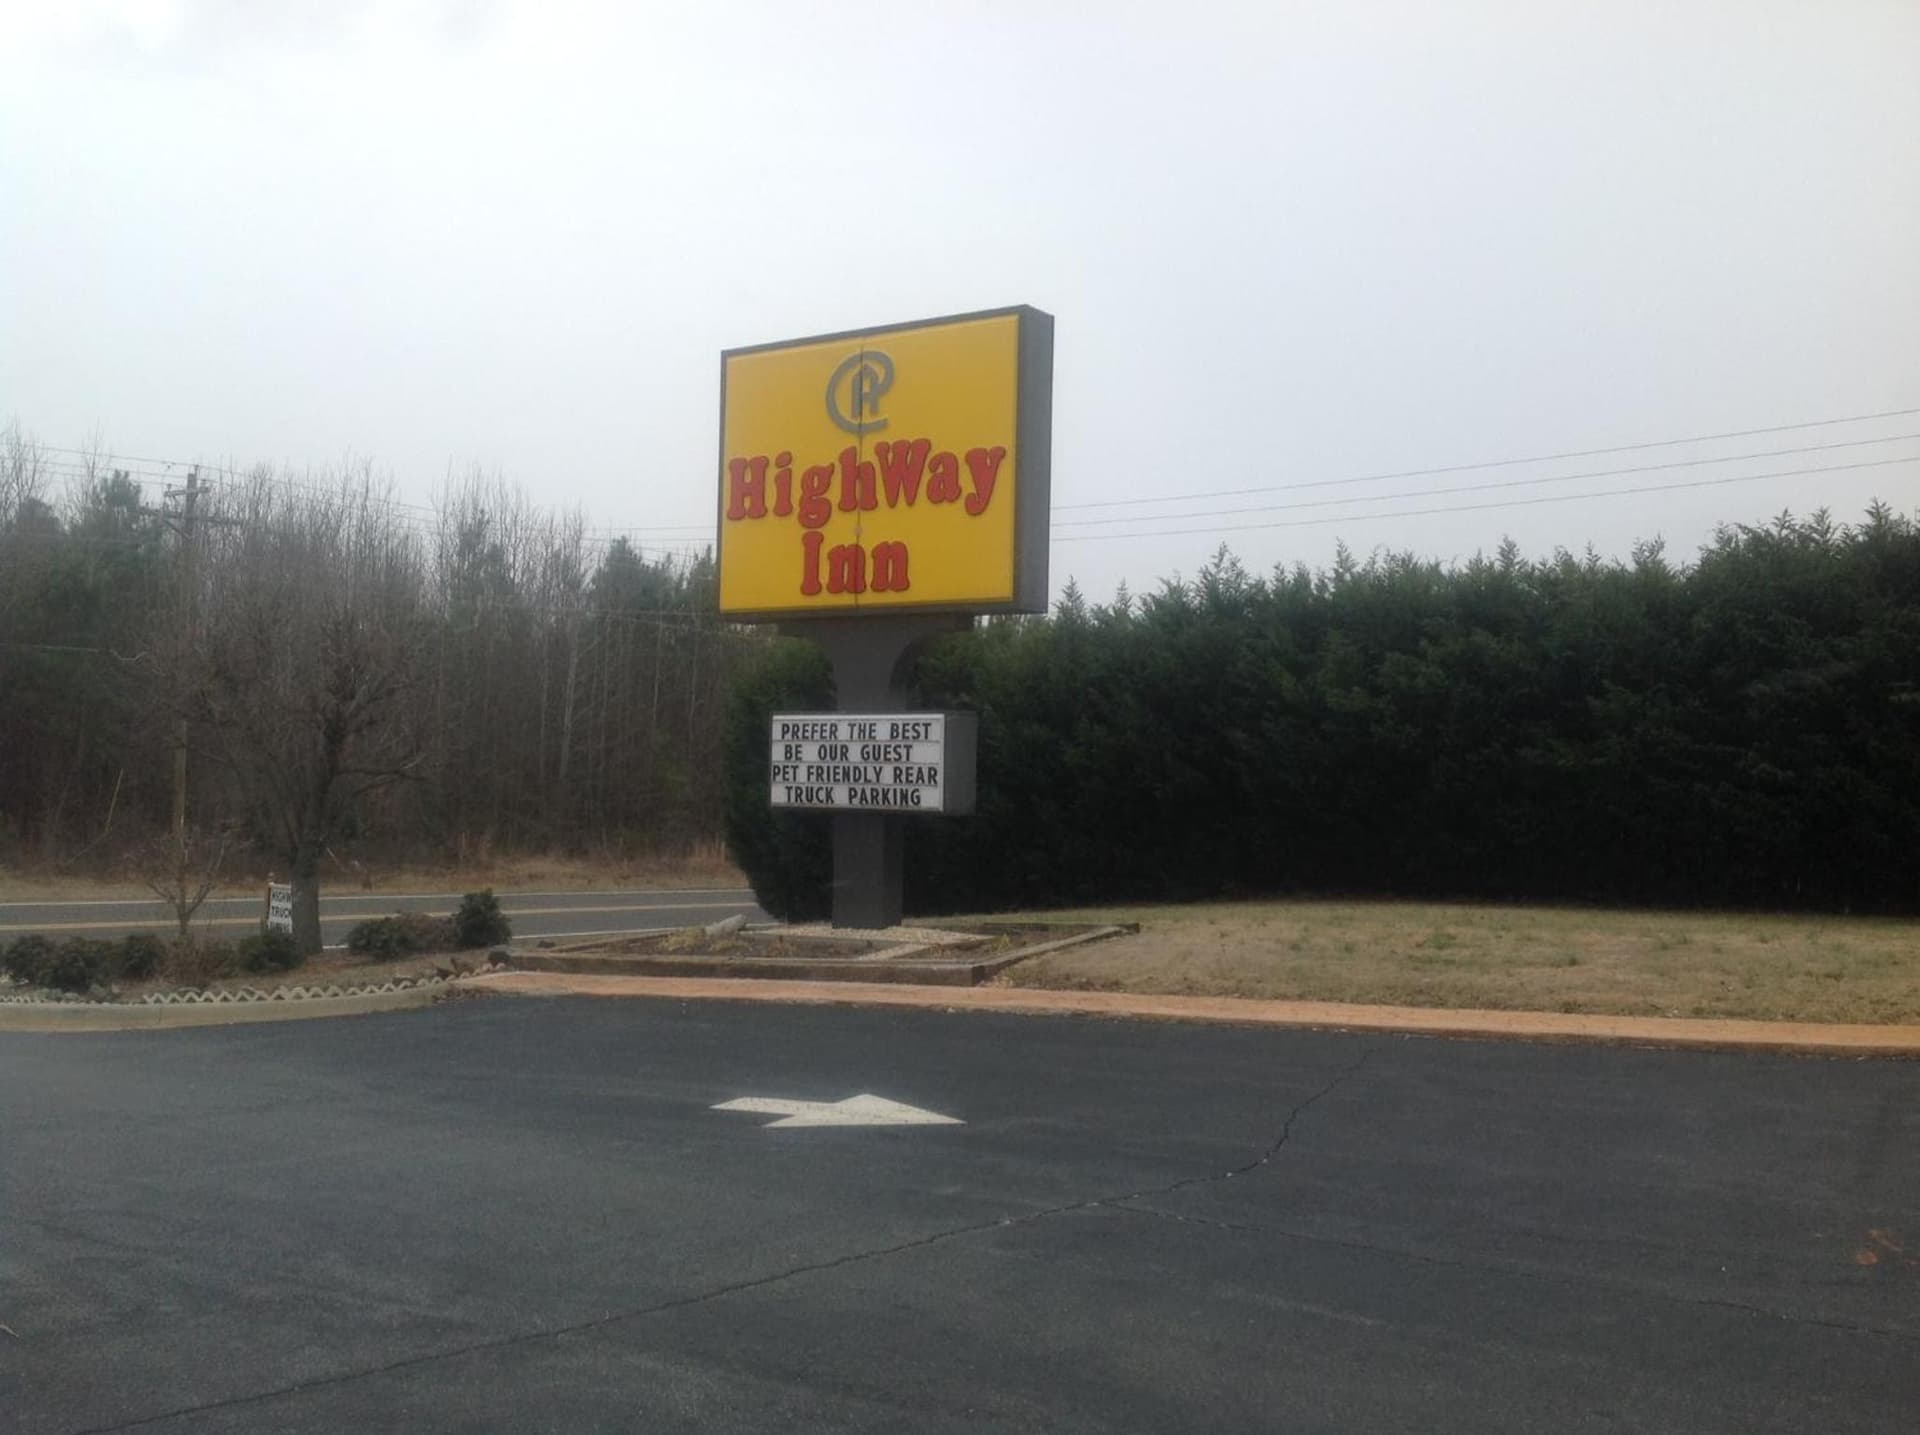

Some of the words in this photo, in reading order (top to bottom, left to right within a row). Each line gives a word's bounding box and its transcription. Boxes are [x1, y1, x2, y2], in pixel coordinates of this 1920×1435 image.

[727, 438, 1006, 529] HighWay
[801, 531, 910, 596] Inn
[782, 723, 838, 740] PREFER
[848, 723, 876, 740] THE
[890, 723, 932, 739] BEST
[785, 744, 803, 760] BE
[818, 744, 849, 761] OUR
[860, 745, 912, 762] GUEST
[773, 765, 799, 781] PET
[807, 766, 883, 783] FRIENDLY
[894, 767, 938, 785] REAR
[786, 786, 834, 804] TRUCK
[848, 787, 921, 806] PARKING
